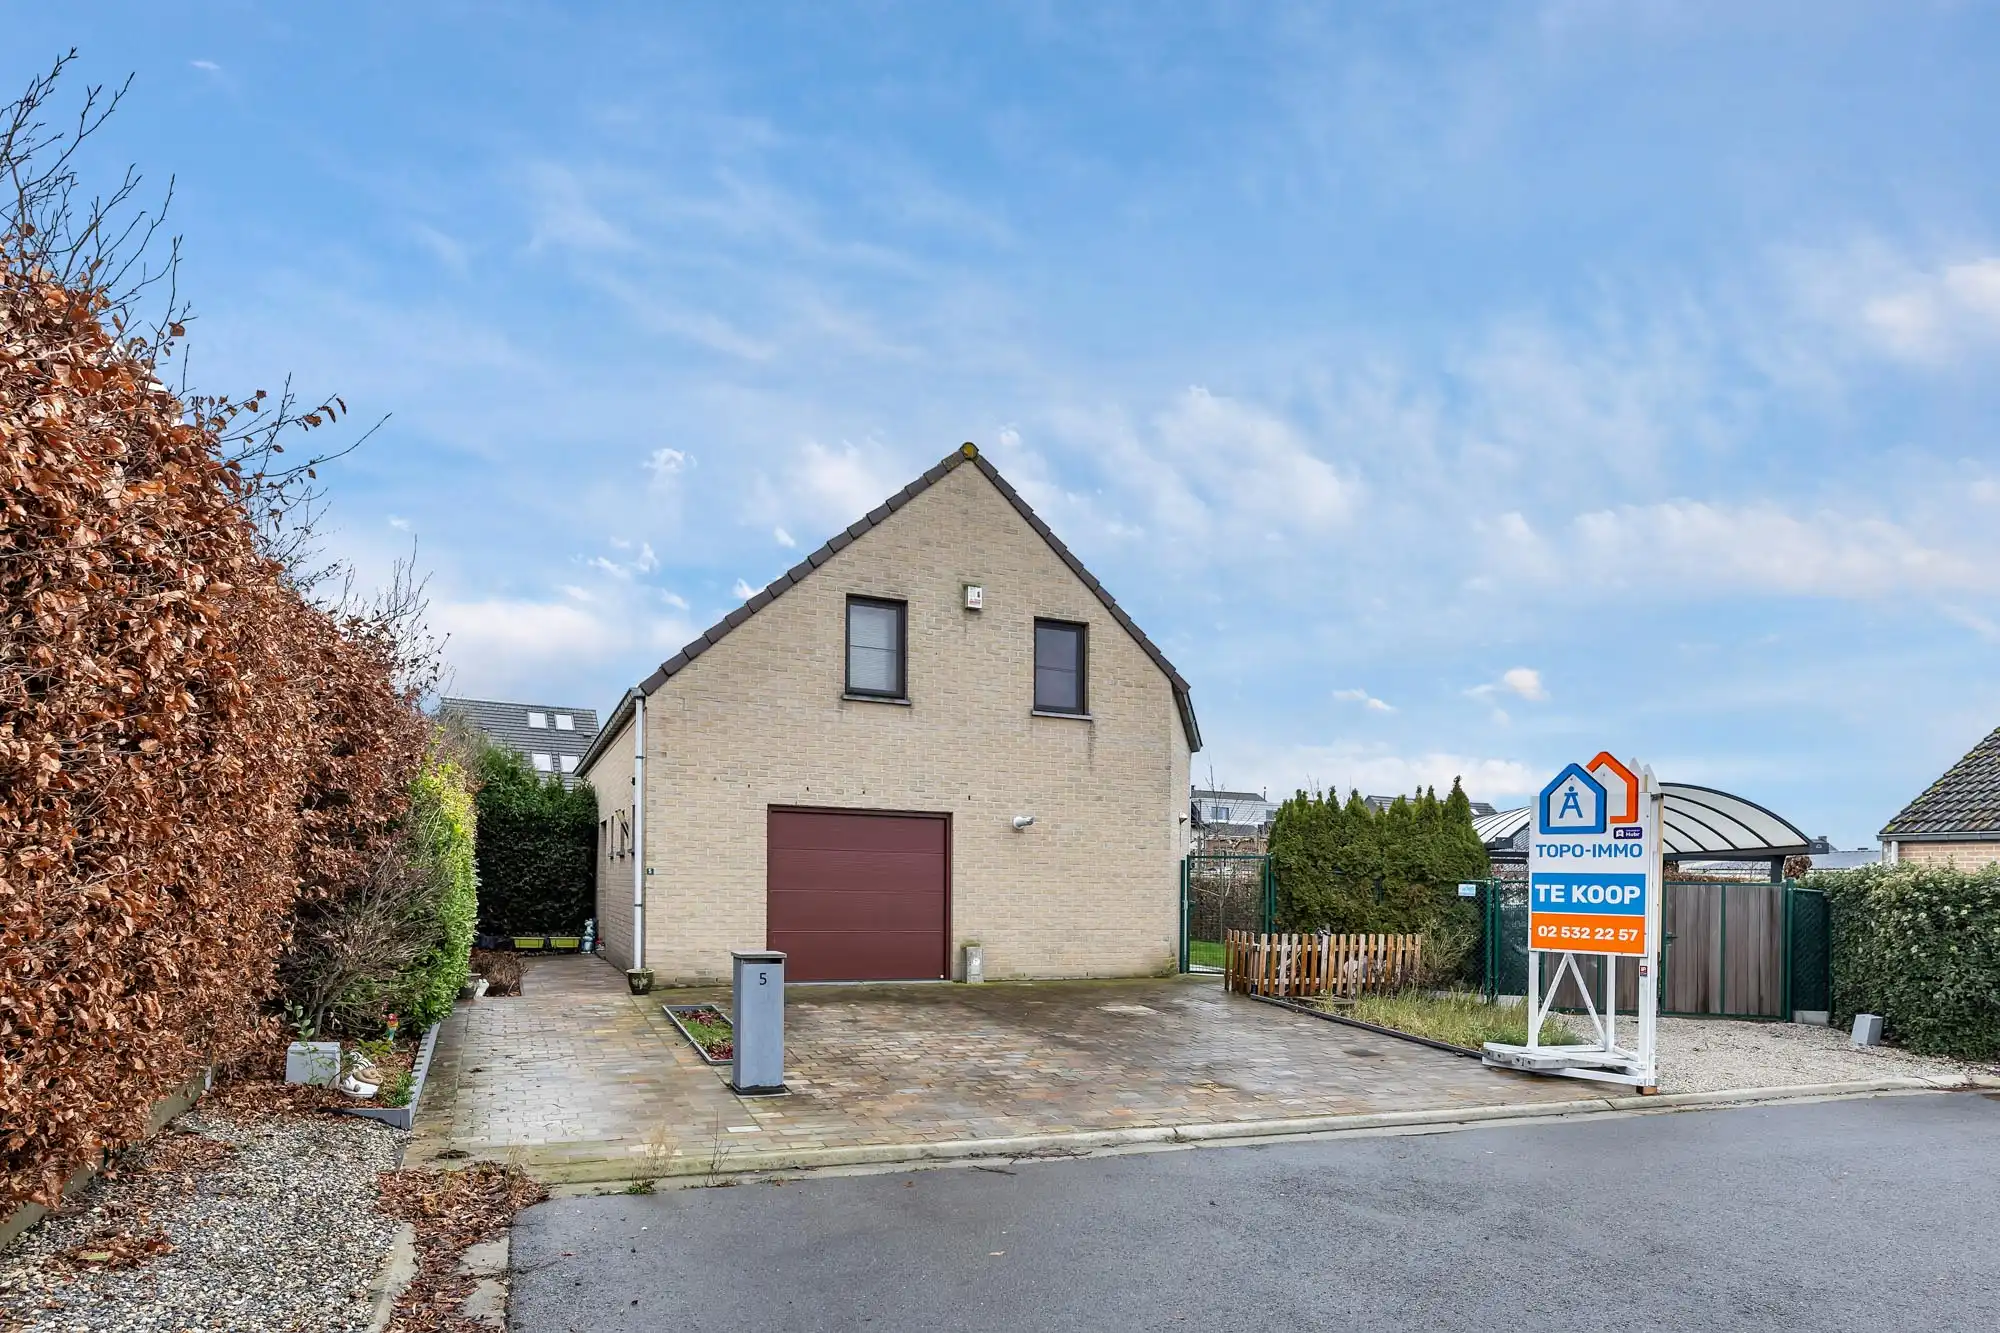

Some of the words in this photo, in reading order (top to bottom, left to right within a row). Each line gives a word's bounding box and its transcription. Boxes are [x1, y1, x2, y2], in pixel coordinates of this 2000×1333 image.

[1536, 843, 1643, 858] TOPO-IMMO
[1535, 884, 1565, 903] TE
[1572, 885, 1641, 905] KOOP
[1538, 926, 1557, 938] 02
[1561, 926, 1590, 939] 532
[1594, 927, 1614, 940] 22
[1618, 929, 1639, 941] 57
[759, 973, 767, 985] 5
